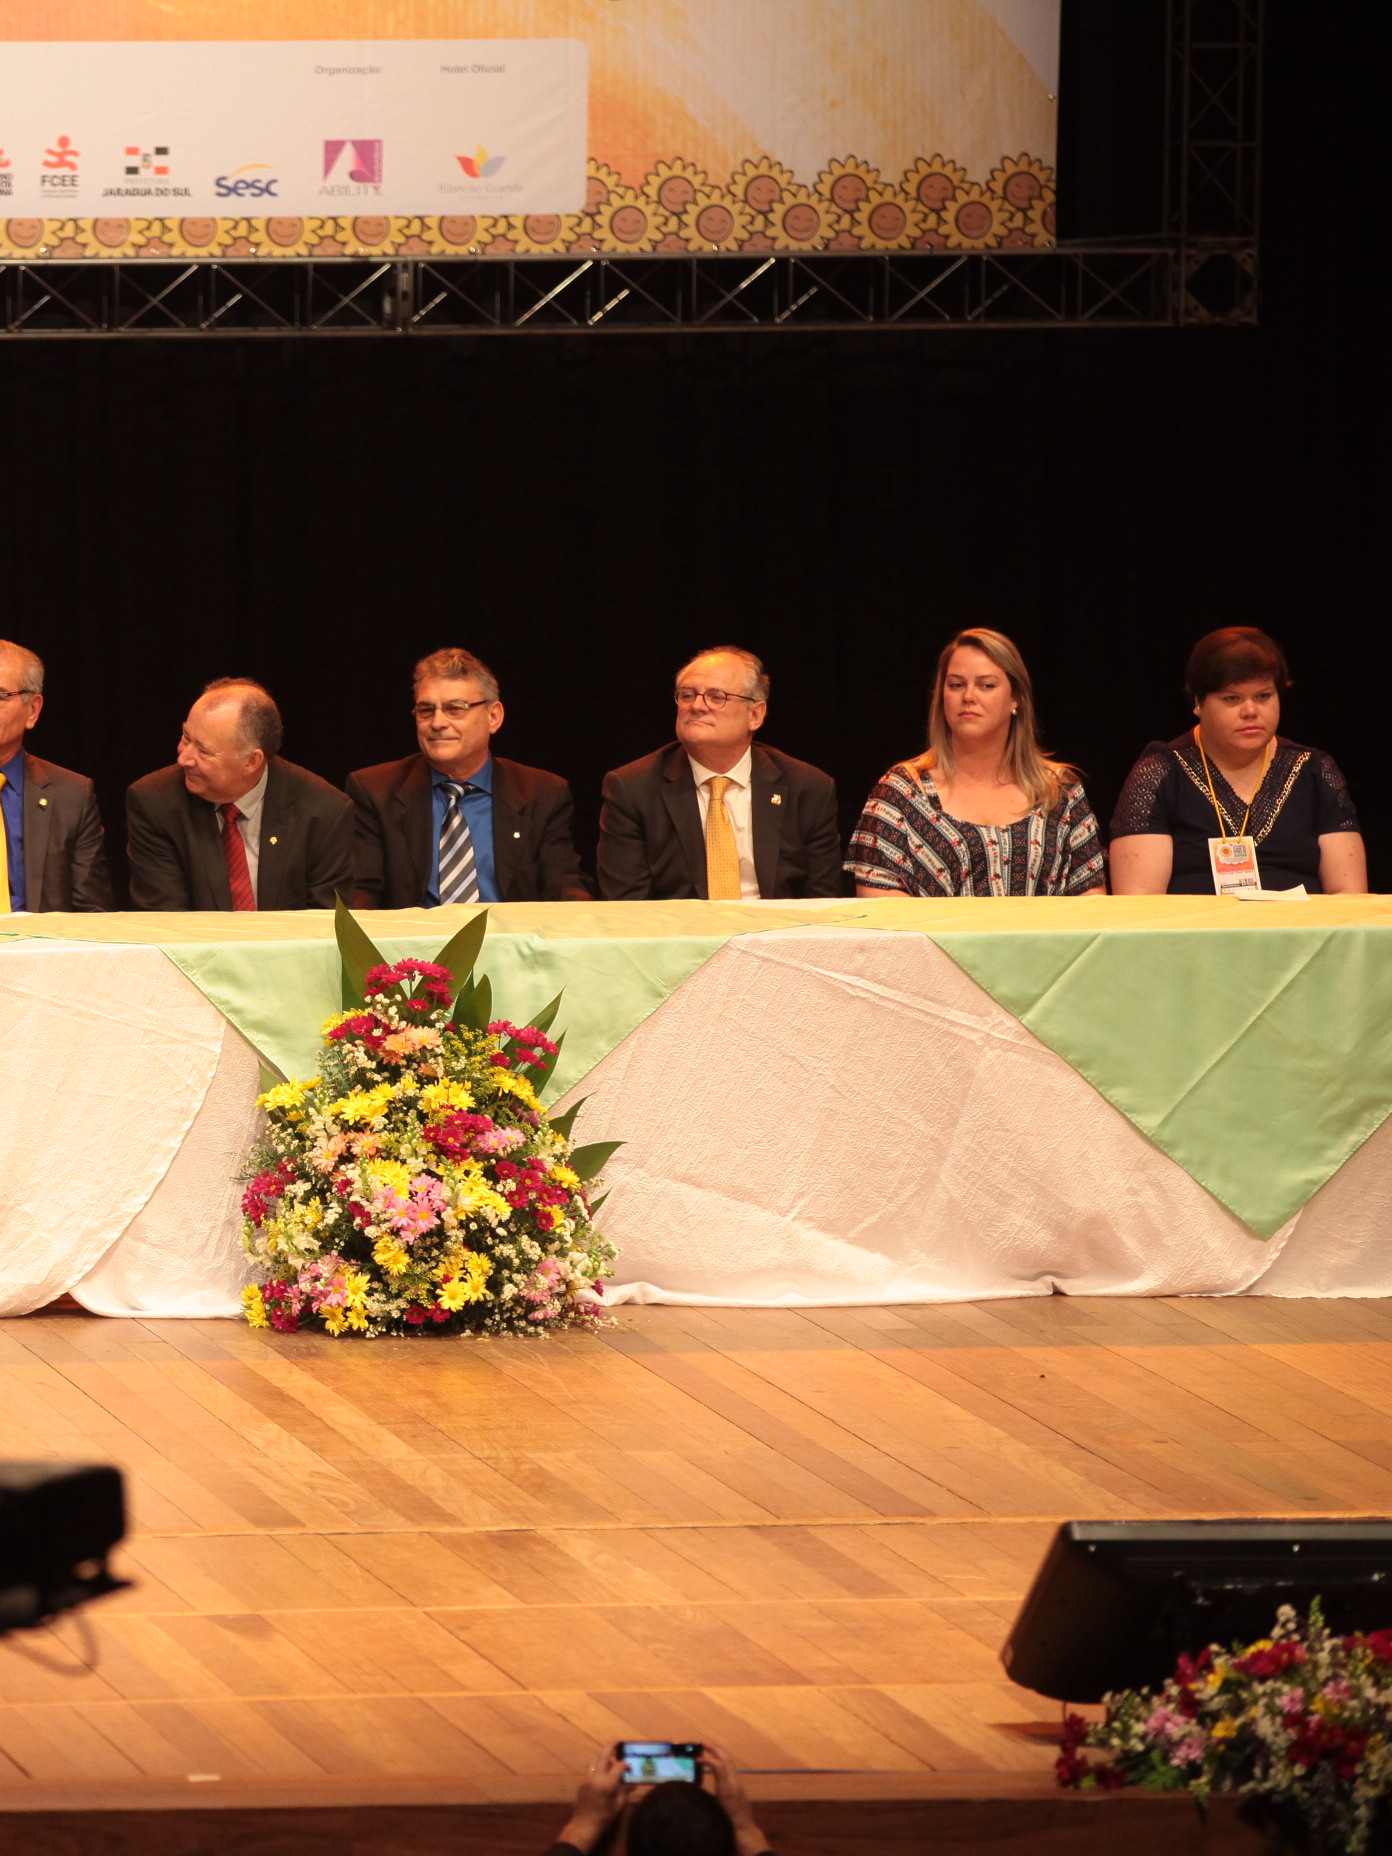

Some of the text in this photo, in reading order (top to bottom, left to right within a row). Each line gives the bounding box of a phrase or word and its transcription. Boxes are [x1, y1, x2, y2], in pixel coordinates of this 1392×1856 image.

[41, 174, 79, 187] FCEE
[172, 187, 192, 197] SUL
[317, 185, 382, 197] ABILITY
